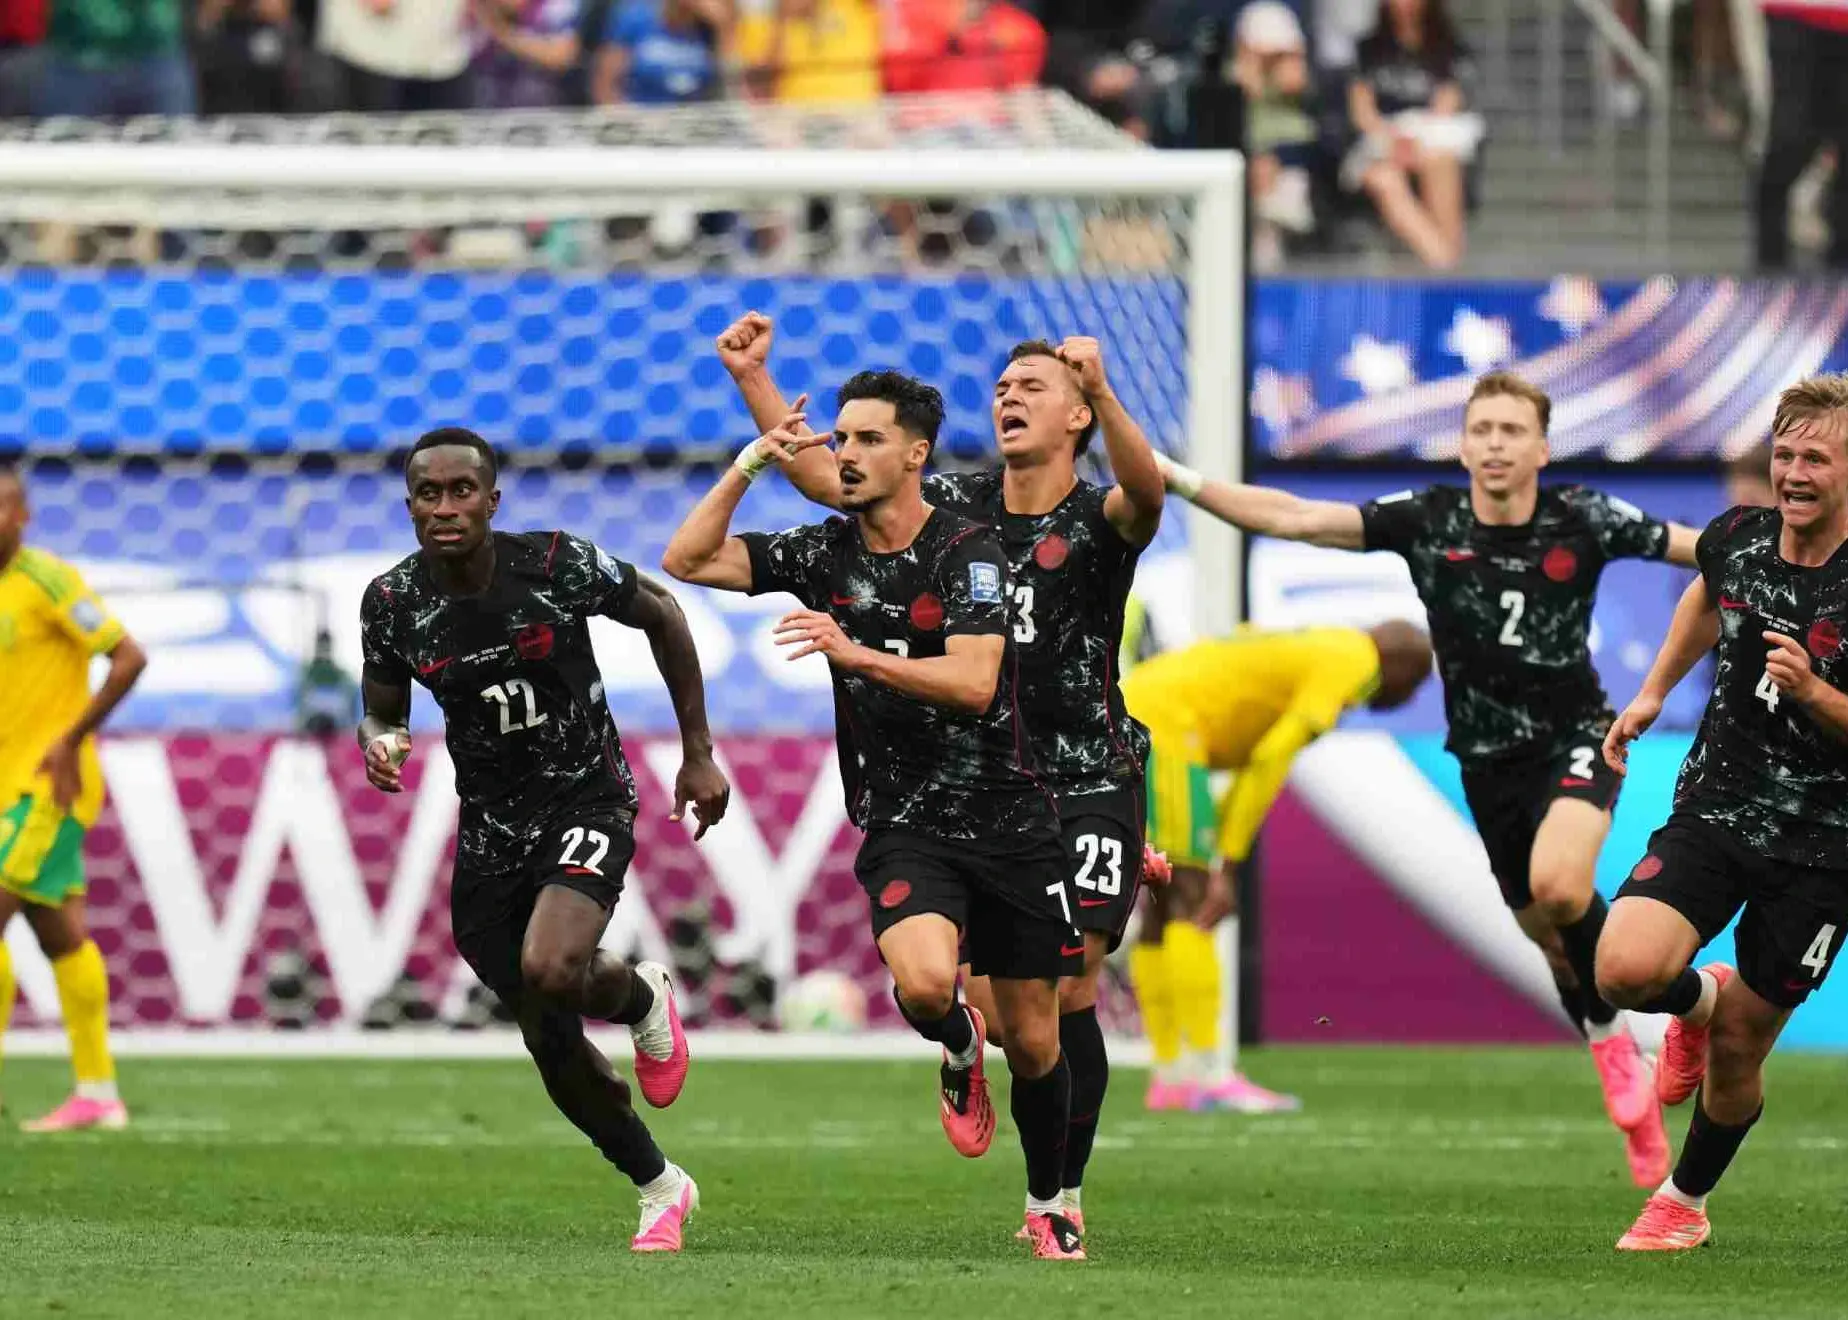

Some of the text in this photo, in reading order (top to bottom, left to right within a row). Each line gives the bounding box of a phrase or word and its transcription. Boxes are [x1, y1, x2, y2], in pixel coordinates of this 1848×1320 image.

[1005, 583, 1036, 644] 3
[1498, 589, 1526, 647] 2
[479, 678, 549, 735] 22
[1754, 670, 1781, 714] 4
[1568, 746, 1596, 780] 2
[3, 736, 848, 1024] WY
[557, 826, 610, 877] 22
[1074, 833, 1123, 896] 23
[1045, 879, 1081, 937] 7
[1800, 922, 1838, 978] 4
